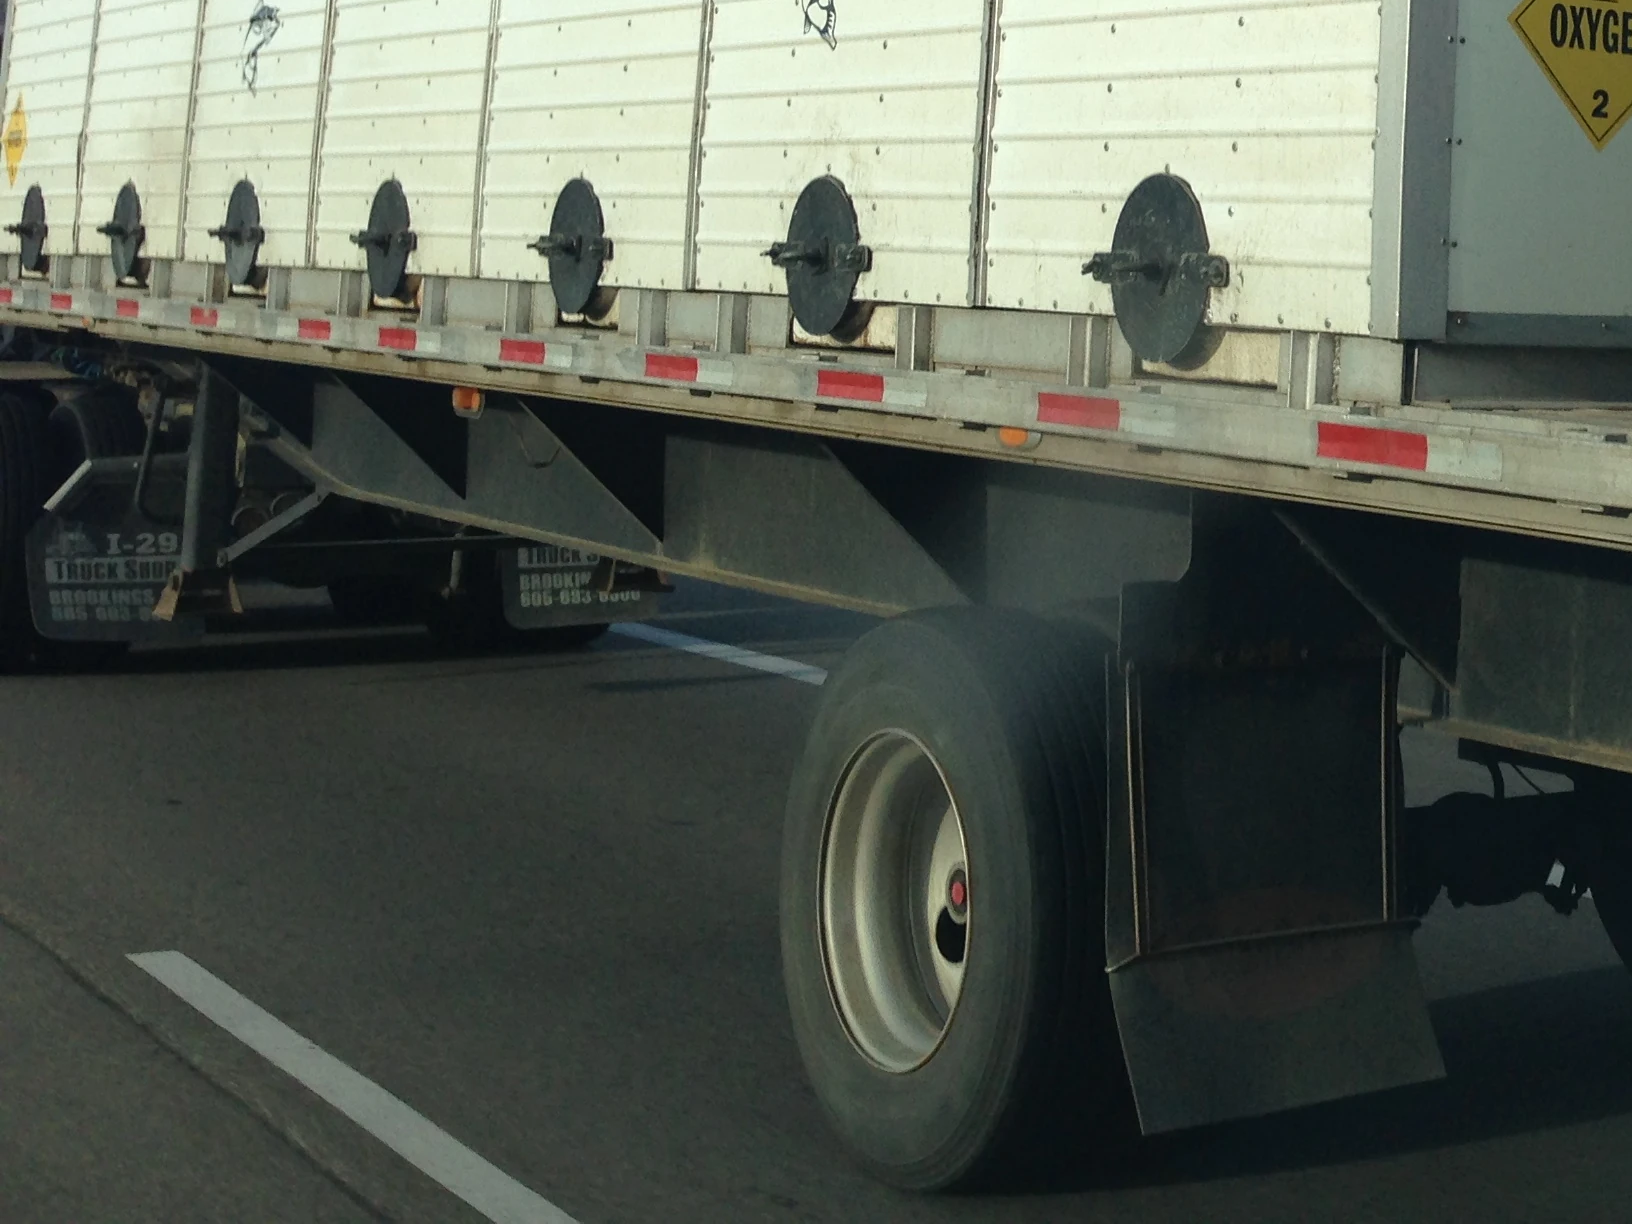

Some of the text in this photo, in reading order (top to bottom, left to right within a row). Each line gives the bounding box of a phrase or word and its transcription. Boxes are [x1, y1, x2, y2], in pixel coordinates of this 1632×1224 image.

[1591, 88, 1610, 120] 2
[106, 531, 179, 555] I-29
[520, 572, 592, 590] BROOKIN
